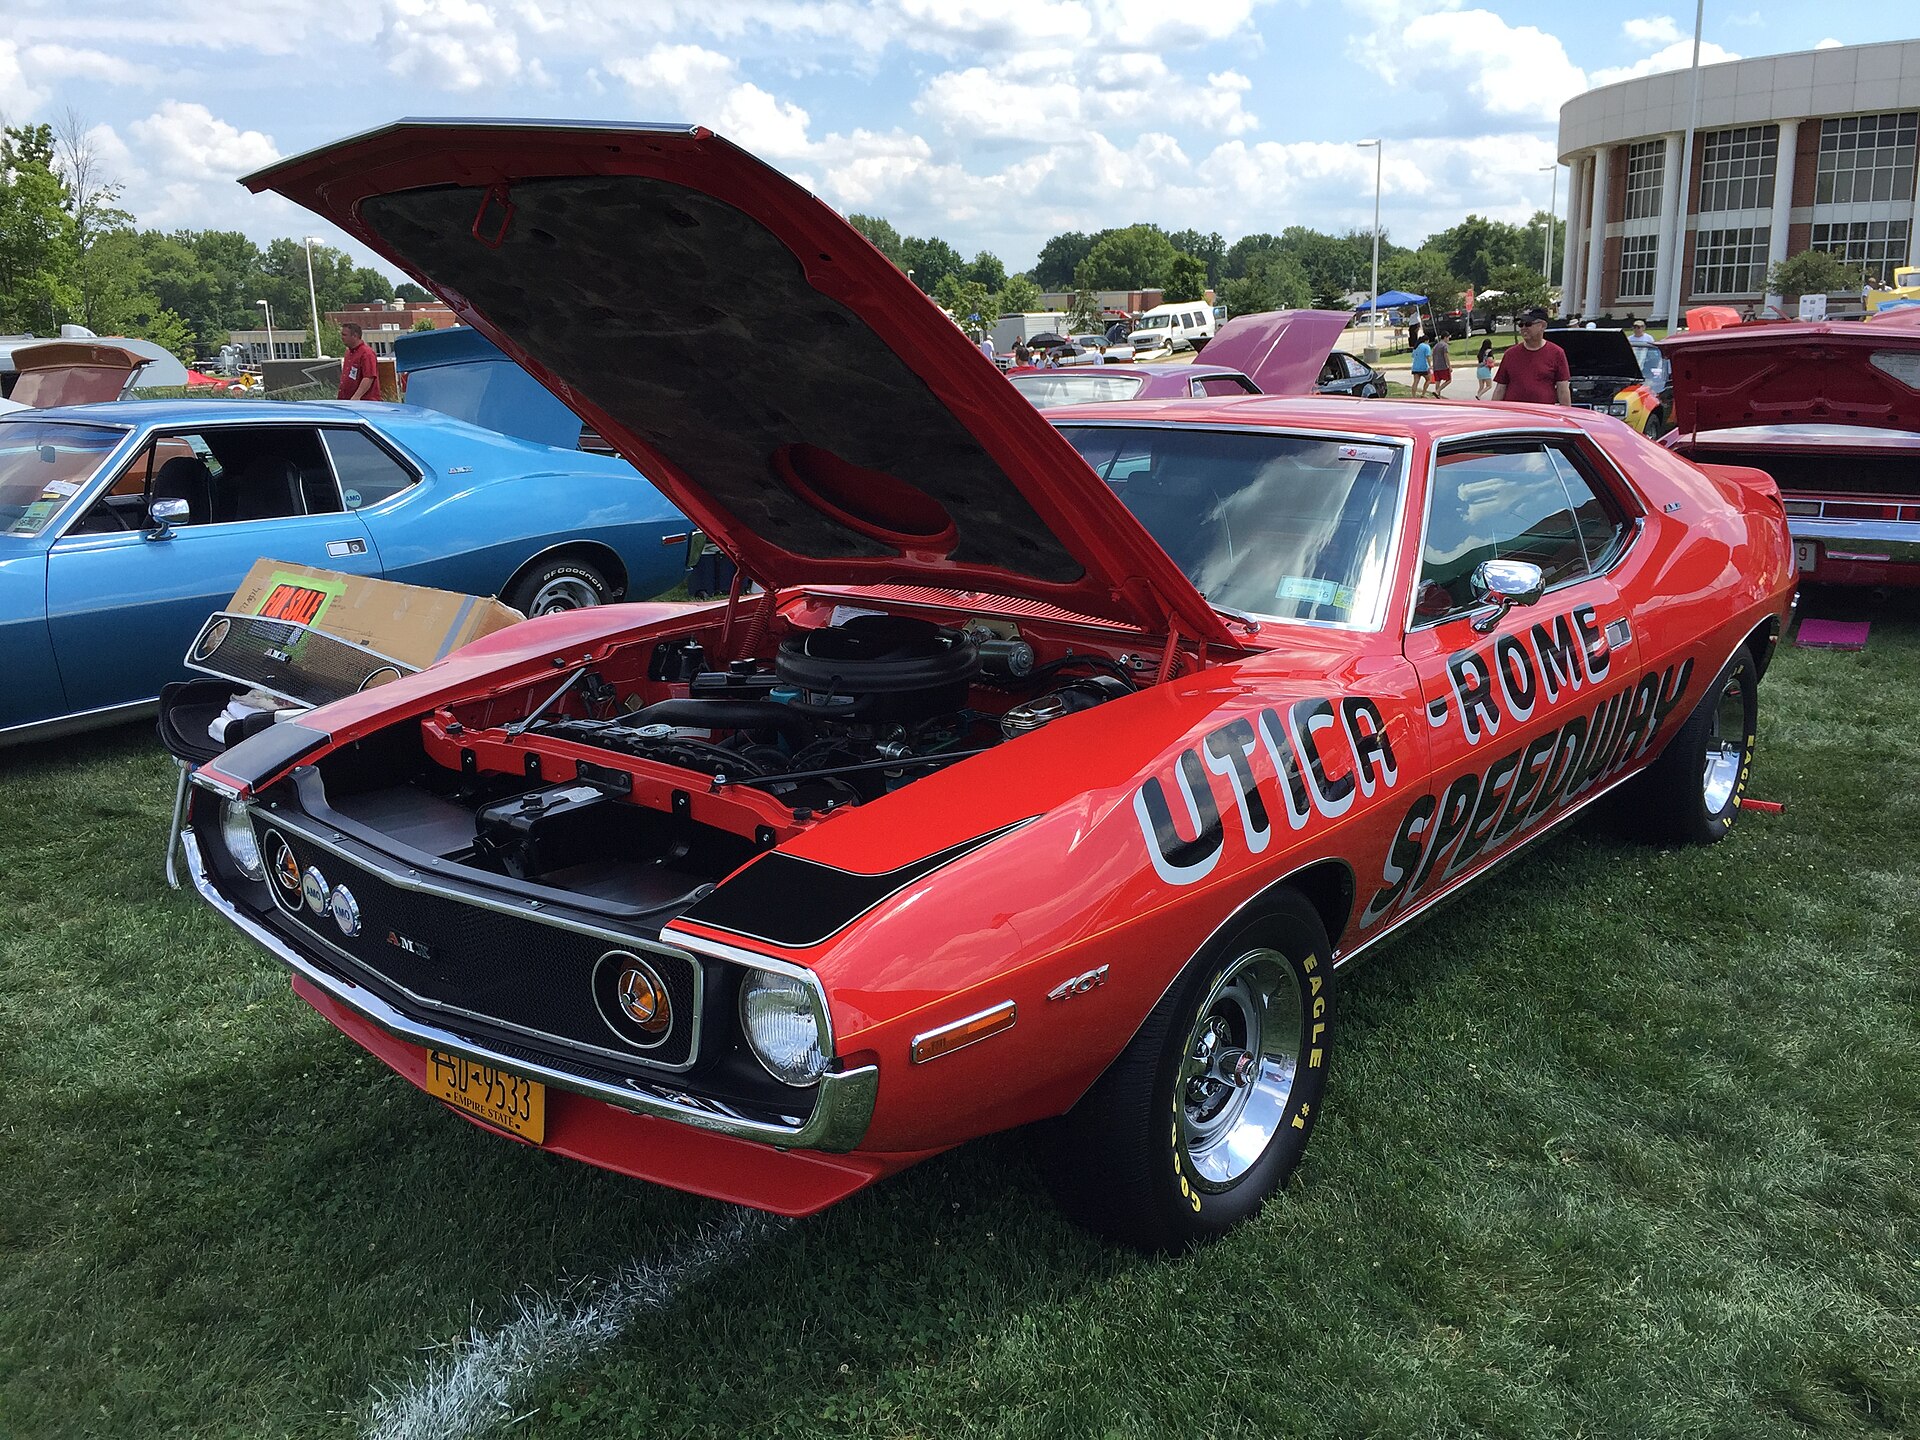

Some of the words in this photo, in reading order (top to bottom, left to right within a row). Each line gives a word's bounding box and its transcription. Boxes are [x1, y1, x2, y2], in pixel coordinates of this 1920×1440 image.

[345, 494, 360, 502] AMO
[543, 567, 603, 591] BFGoodrich
[258, 585, 296, 618] FOR
[280, 587, 327, 625] SALE
[1732, 735, 1755, 808] EAGLE
[1132, 696, 1398, 886] UTICA
[1359, 656, 1695, 930] SPEEDWAY
[306, 885, 321, 901] AMO
[334, 905, 350, 920] AMO
[387, 931, 430, 959] AMX
[1047, 964, 1110, 1001] 401
[1303, 952, 1326, 1068] EAGLE
[453, 1091, 486, 1115] EMPIRE
[487, 1108, 514, 1128] STATE
[1291, 1102, 1311, 1130] #1
